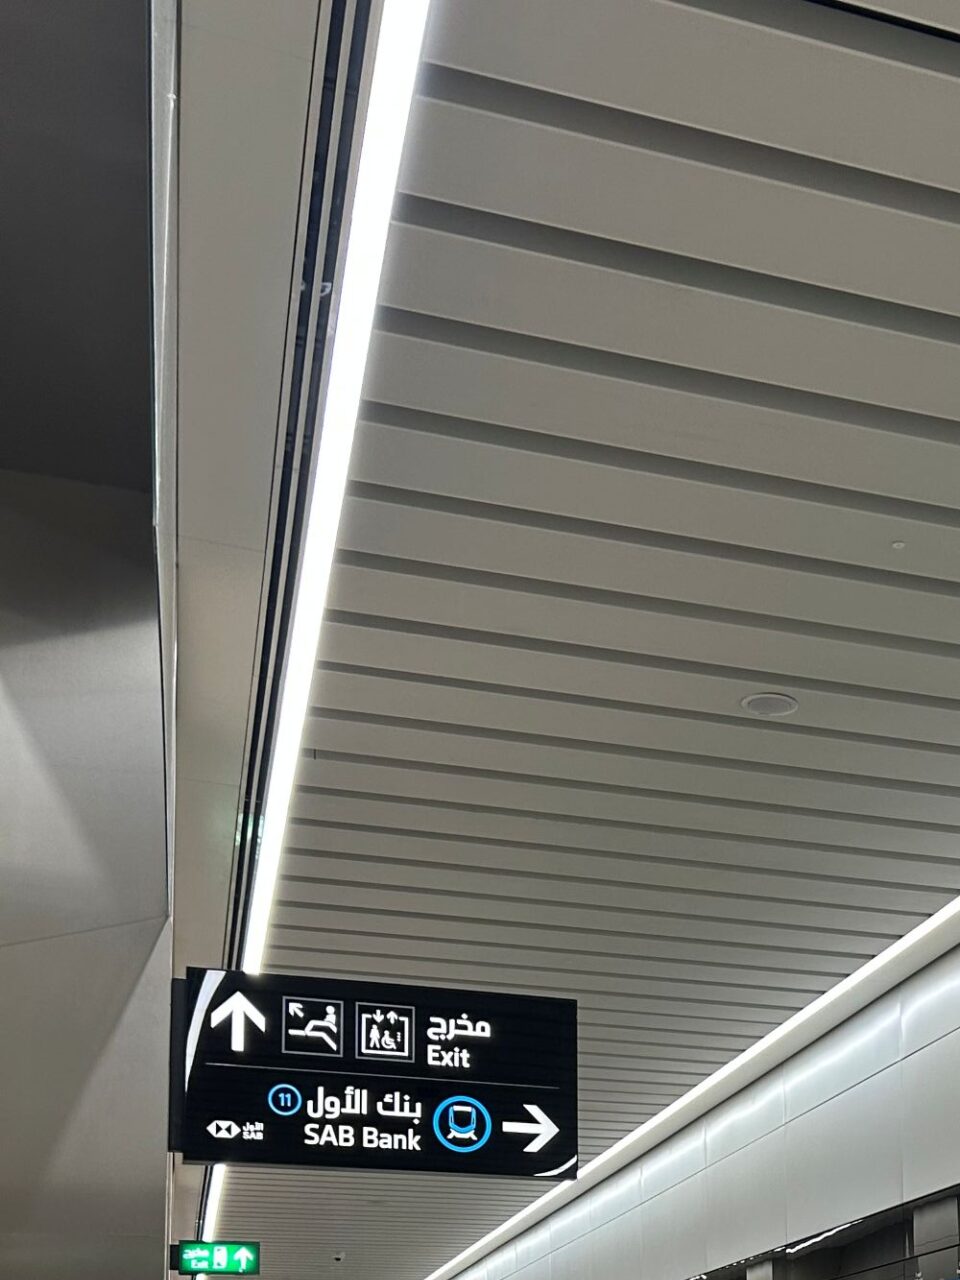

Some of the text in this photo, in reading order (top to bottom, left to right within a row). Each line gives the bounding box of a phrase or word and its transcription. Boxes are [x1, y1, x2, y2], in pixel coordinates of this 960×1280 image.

[427, 1013, 491, 1041] مخرج
[427, 1045, 471, 1069] Exit
[278, 1093, 292, 1107] 11
[306, 1086, 422, 1124] بنك الأول
[242, 1131, 264, 1141] SAB
[304, 1123, 422, 1151] SAB Bank
